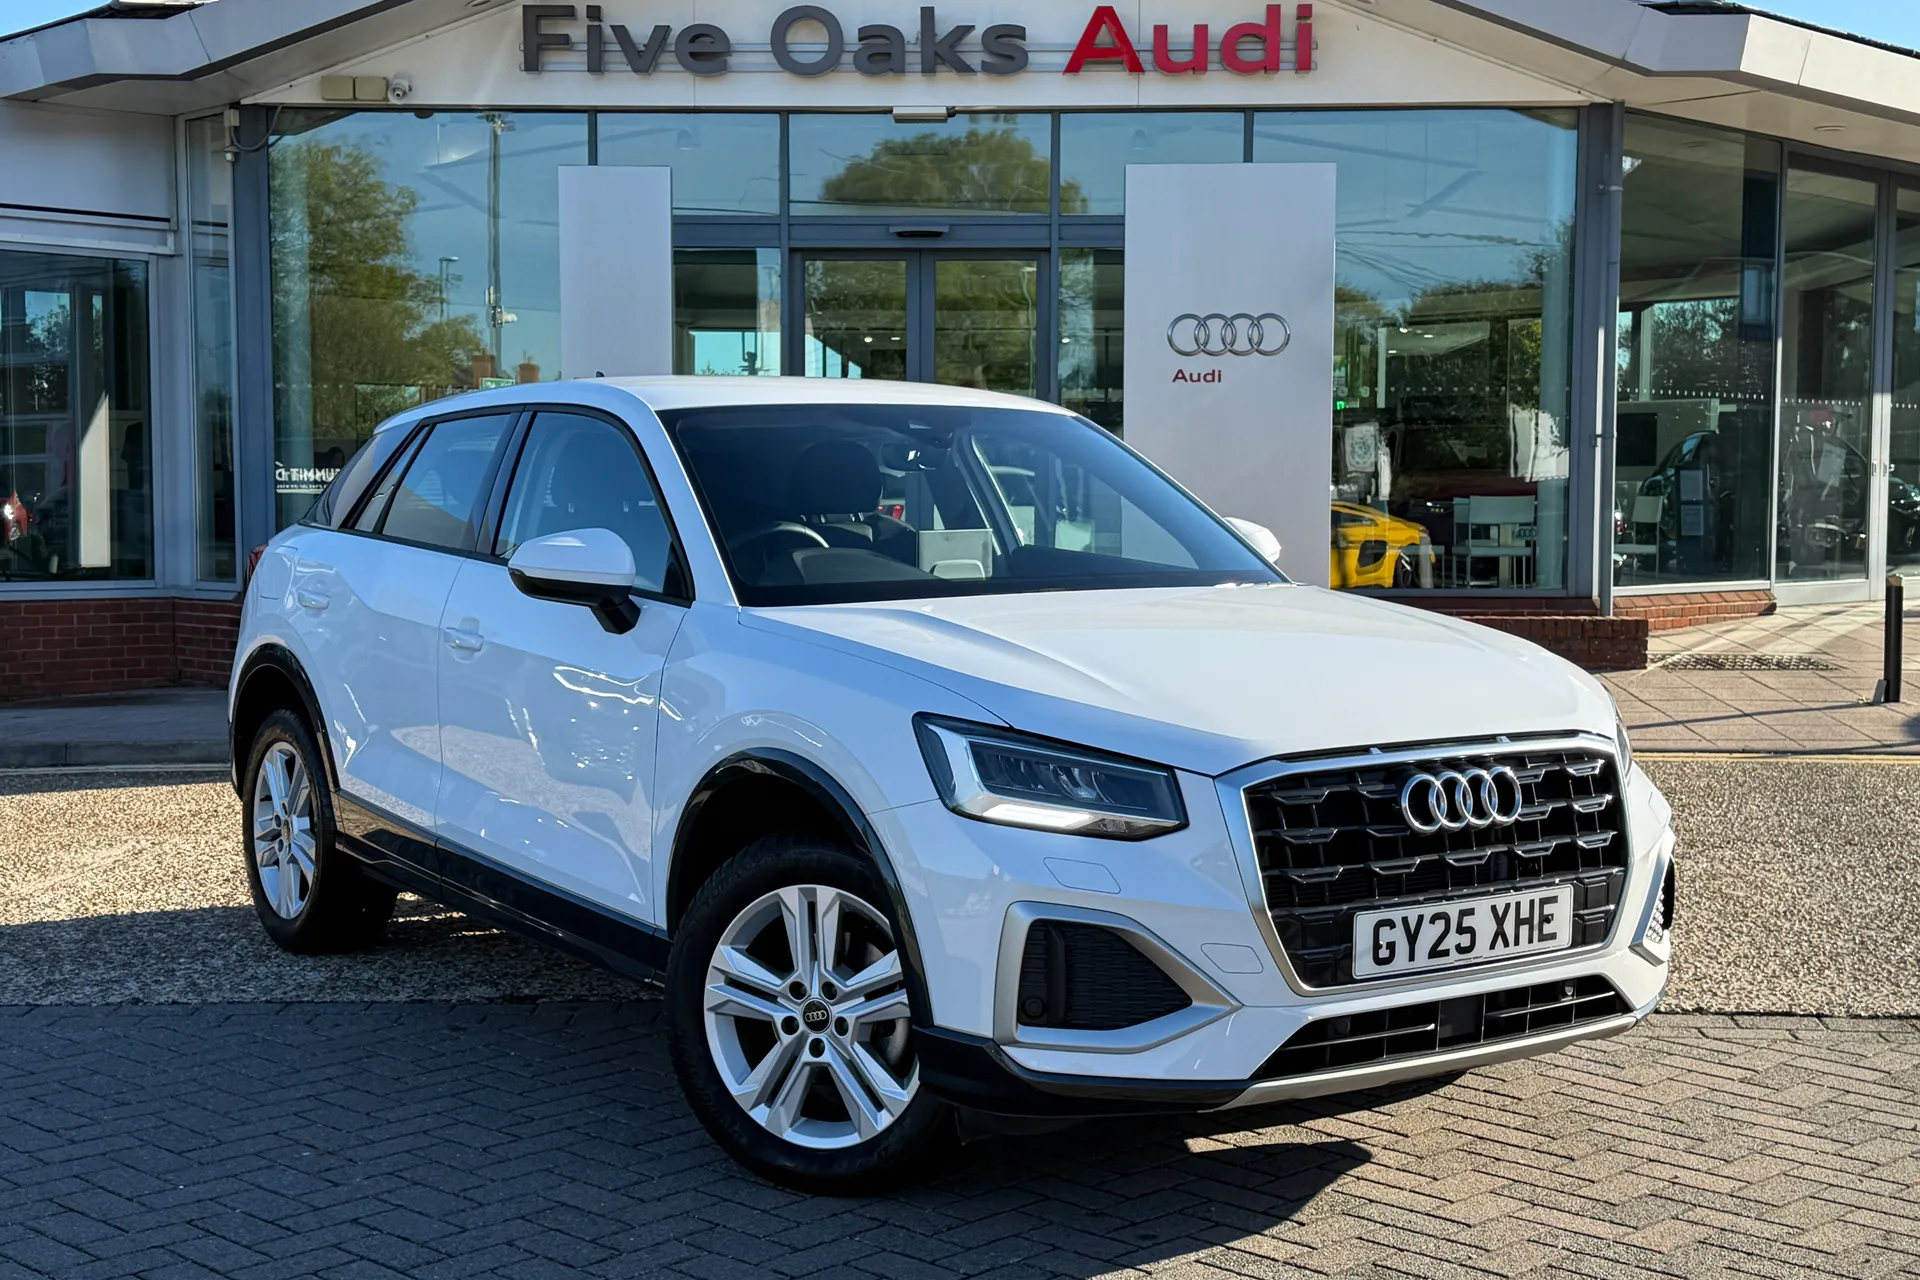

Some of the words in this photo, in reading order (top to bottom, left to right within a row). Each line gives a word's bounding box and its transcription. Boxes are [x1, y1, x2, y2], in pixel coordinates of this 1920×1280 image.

[523, 4, 732, 76] Five
[770, 4, 1029, 77] Oaks
[1063, 4, 1313, 76] Audi
[1172, 368, 1222, 383] Audi
[1372, 907, 1477, 966] GY25
[1489, 895, 1559, 950] XHE
